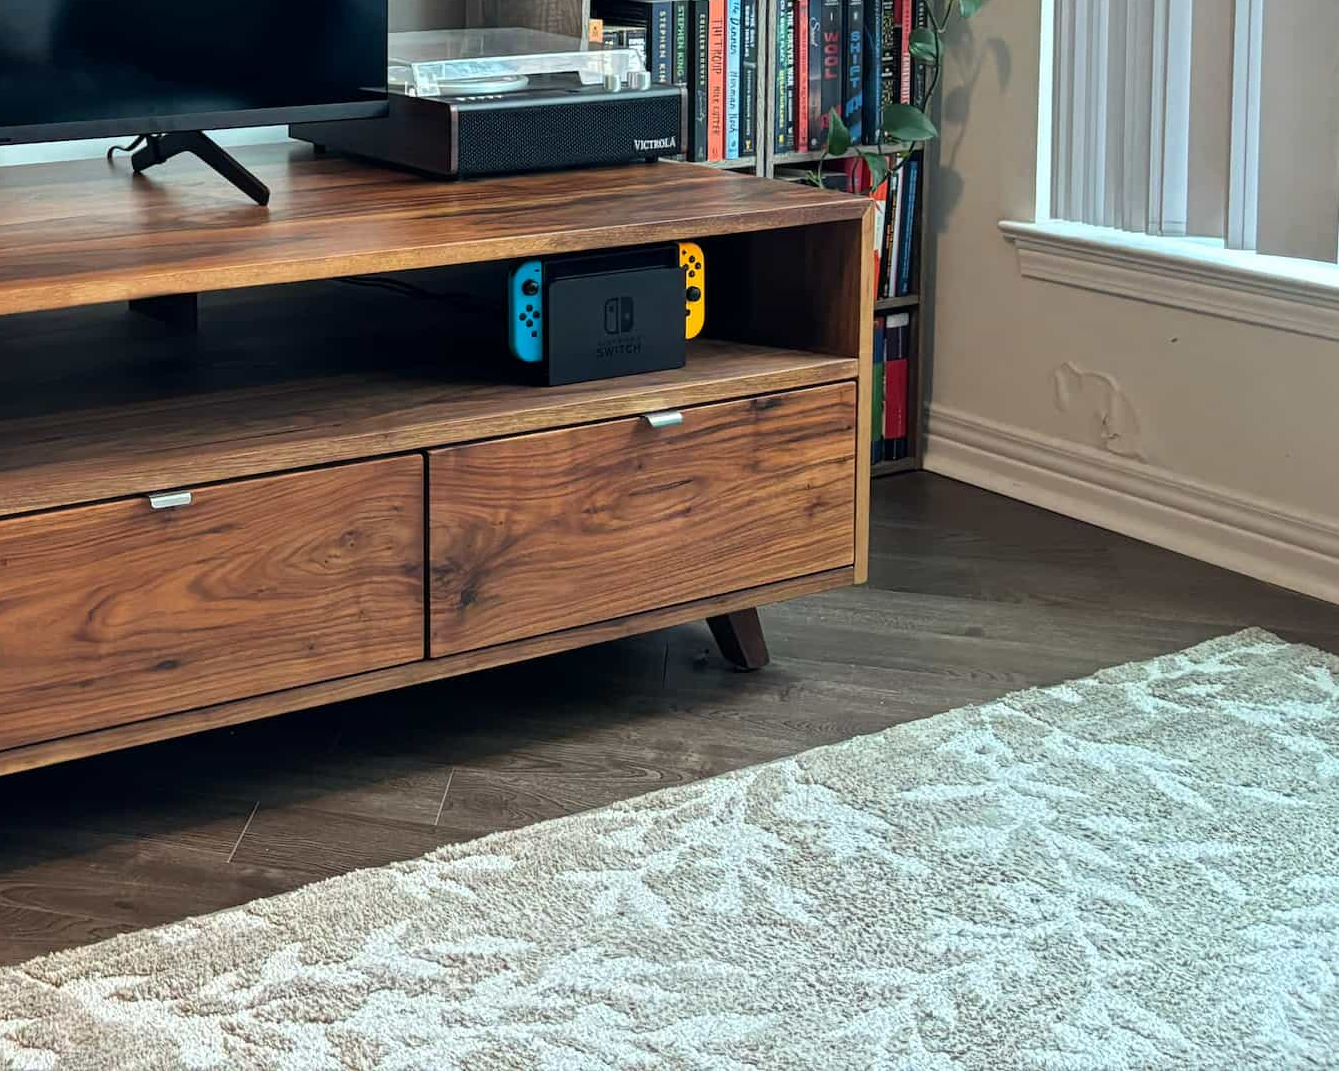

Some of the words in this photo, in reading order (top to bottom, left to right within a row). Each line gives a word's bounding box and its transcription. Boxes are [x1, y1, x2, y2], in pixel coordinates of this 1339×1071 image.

[730, 17, 740, 55] Dinner
[824, 32, 839, 79] WOOL
[850, 31, 860, 88] SHIFT
[711, 106, 720, 135] CUTTER
[634, 136, 677, 150] VICTROLA
[596, 344, 642, 359] SWITCH
